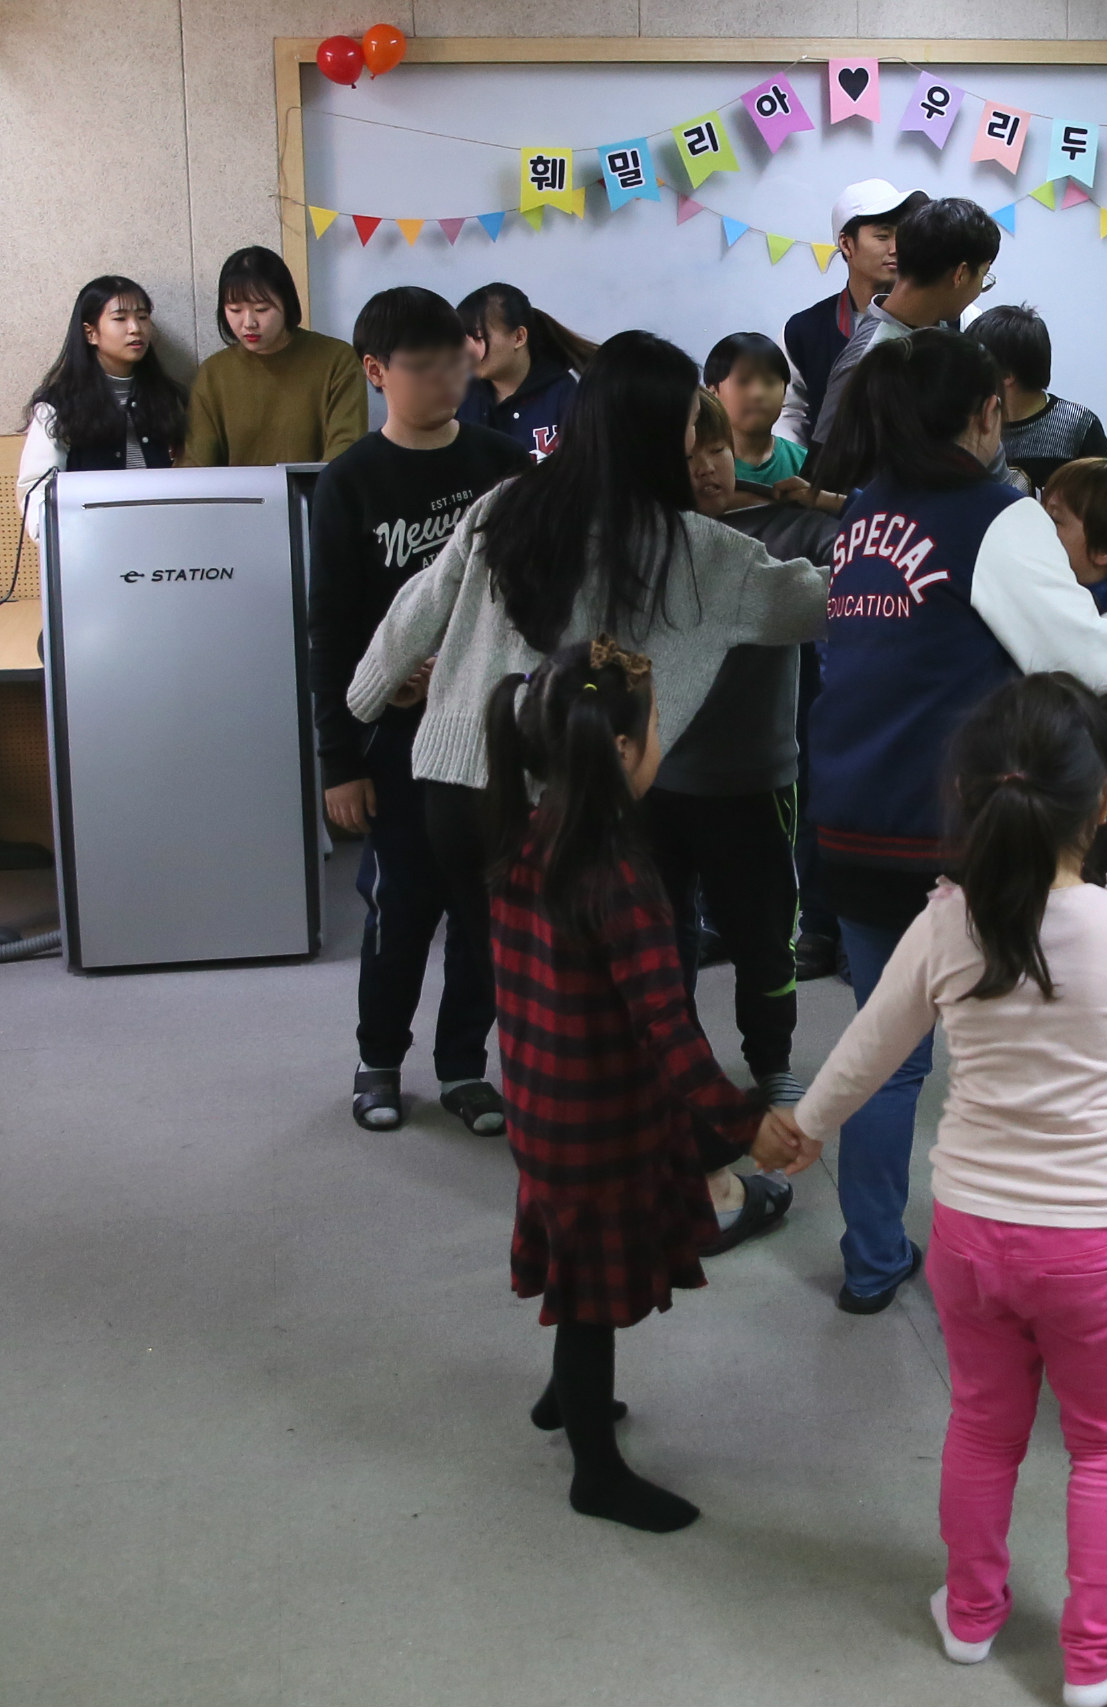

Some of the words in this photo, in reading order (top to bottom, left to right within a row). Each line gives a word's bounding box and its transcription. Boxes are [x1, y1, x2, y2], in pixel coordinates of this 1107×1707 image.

[529, 84, 791, 191] 훼밀리아
[431, 489, 474, 511] EST.1981
[151, 567, 234, 582] STATION
[832, 512, 950, 605] SPECIAL
